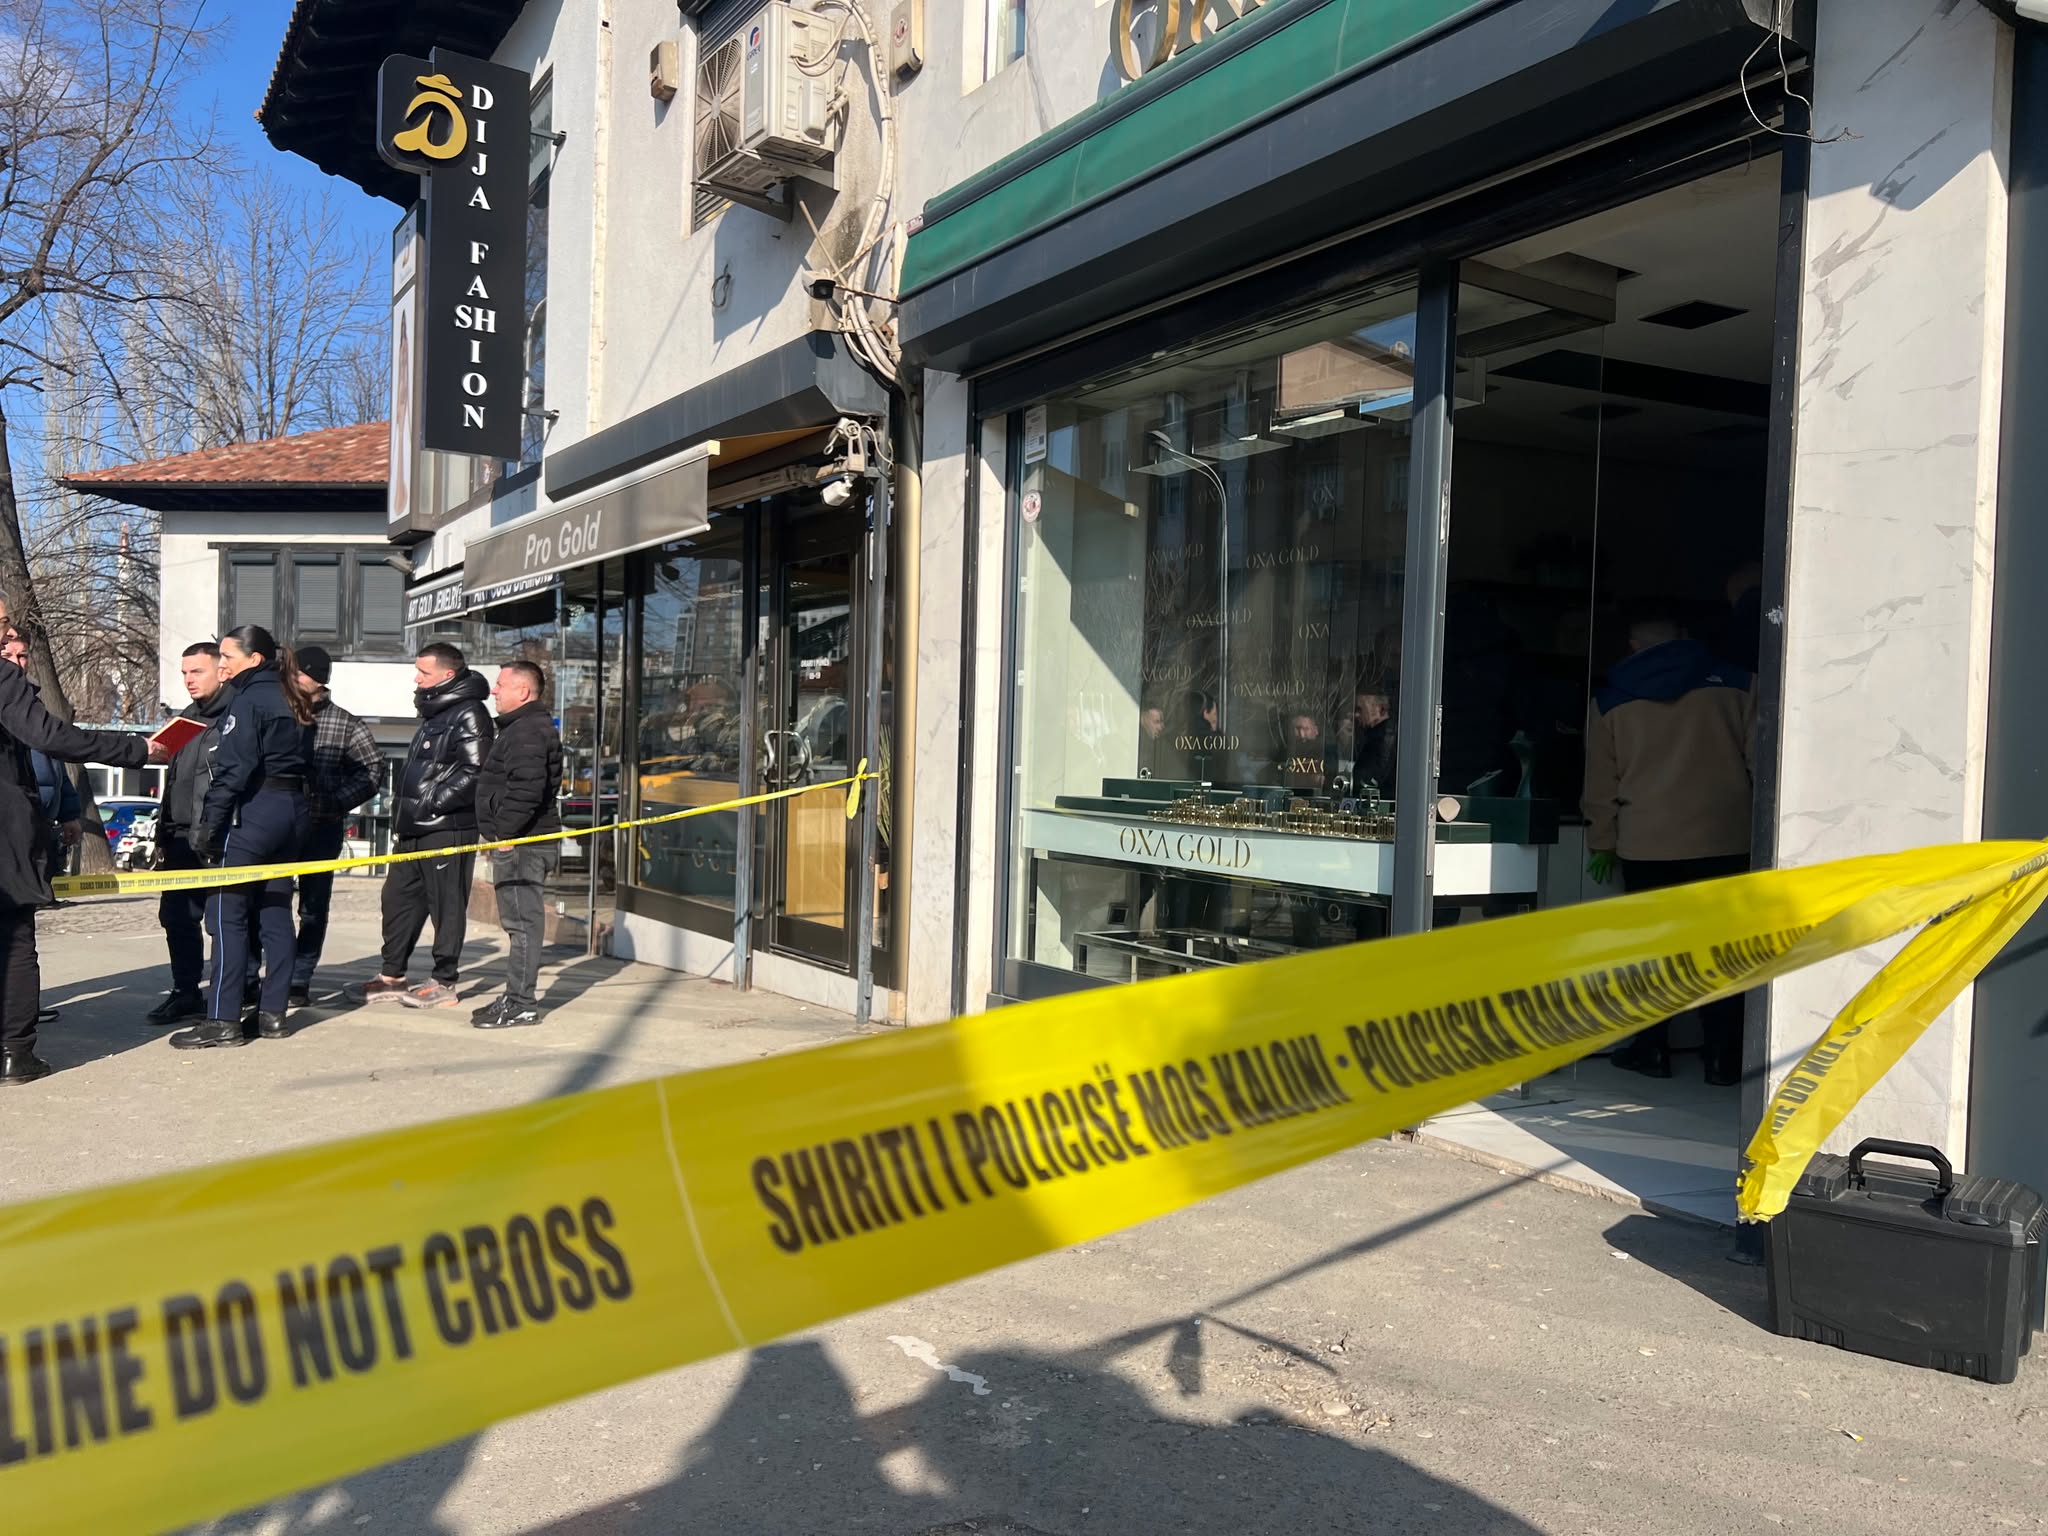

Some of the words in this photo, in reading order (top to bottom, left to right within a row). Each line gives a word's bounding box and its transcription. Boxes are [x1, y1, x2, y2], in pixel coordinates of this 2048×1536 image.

[468, 84, 494, 211] DIJA
[455, 240, 496, 430] FASHION
[523, 533, 552, 570] Pro
[558, 510, 602, 559] Gold
[1246, 554, 1276, 570] OXA
[1278, 543, 1320, 566] GOLD
[408, 598, 419, 622] ART
[418, 593, 433, 619] GOLD
[1186, 613, 1213, 629] OXA
[1233, 681, 1262, 698] OXA
[1264, 679, 1305, 698] GOLD
[1174, 735, 1201, 751] OXA
[1203, 734, 1240, 751] GOLD
[1119, 826, 1171, 860] OXA
[1176, 832, 1252, 870] GOLD
[751, 1123, 947, 1255] SHIRITI
[927, 1116, 972, 1206] I
[951, 1062, 1152, 1198] POLICISË
[1126, 1058, 1234, 1150] MOS
[1209, 1032, 1353, 1129] KALONI
[1498, 976, 1617, 1051] TRAKA
[1580, 968, 1650, 1028] NE
[0, 1305, 153, 1466] LINE
[161, 1278, 270, 1423] DO
[276, 1243, 414, 1389] NOT
[422, 1196, 635, 1347] CROSS
